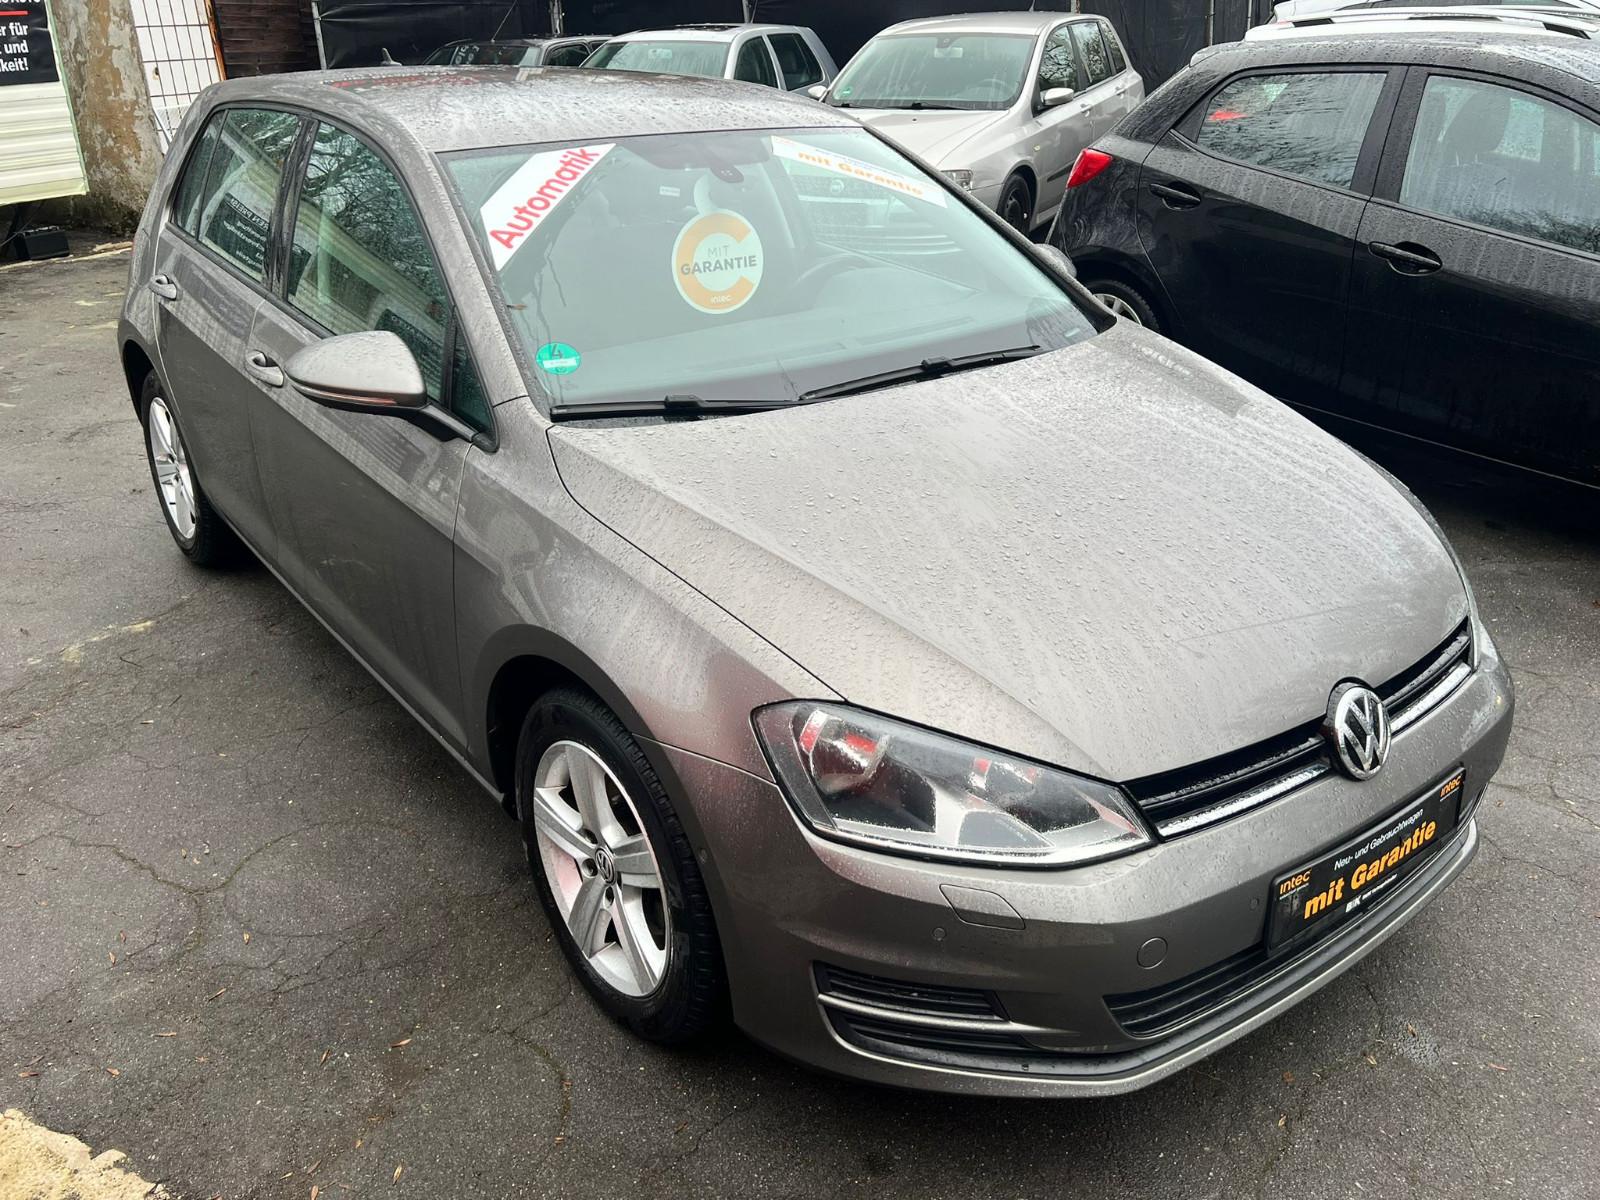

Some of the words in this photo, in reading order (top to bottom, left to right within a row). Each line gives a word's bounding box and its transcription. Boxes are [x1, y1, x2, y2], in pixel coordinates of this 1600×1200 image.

[8, 22, 28, 36] für
[4, 40, 29, 54] und
[798, 152, 832, 167] mit
[837, 161, 924, 196] Garantie
[489, 148, 600, 249] Automatik
[680, 255, 758, 276] GARANTIE
[707, 244, 730, 258] MIT
[1334, 855, 1354, 871] Neu-
[1354, 842, 1370, 860] und
[1369, 808, 1424, 850] Gebrauchtwagen
[1303, 877, 1345, 920] mit
[1350, 820, 1437, 890] Garantie
